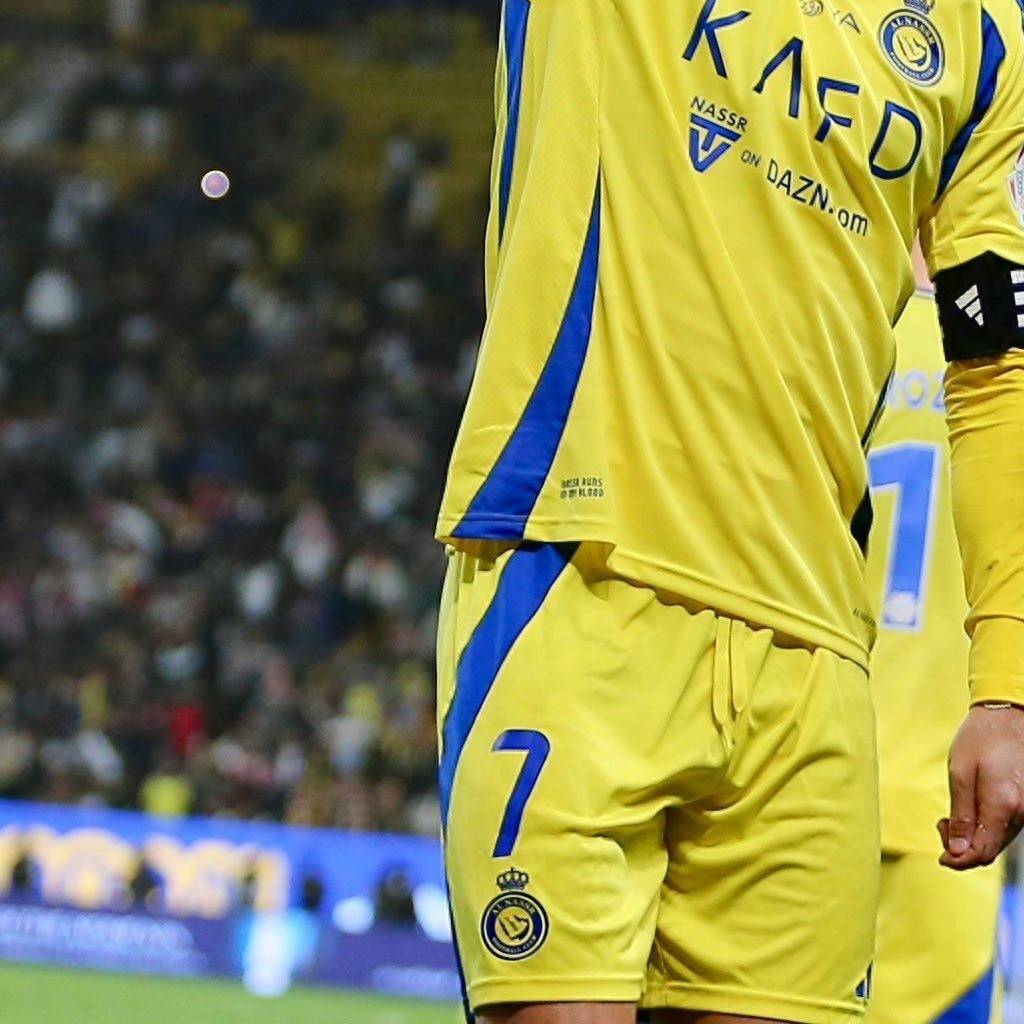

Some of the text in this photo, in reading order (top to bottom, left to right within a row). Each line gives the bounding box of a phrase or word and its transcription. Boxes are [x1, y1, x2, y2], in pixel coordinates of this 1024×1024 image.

[690, 96, 748, 132] NASSR
[740, 150, 868, 236] ON DAZN.om
[491, 729, 551, 859] 7
